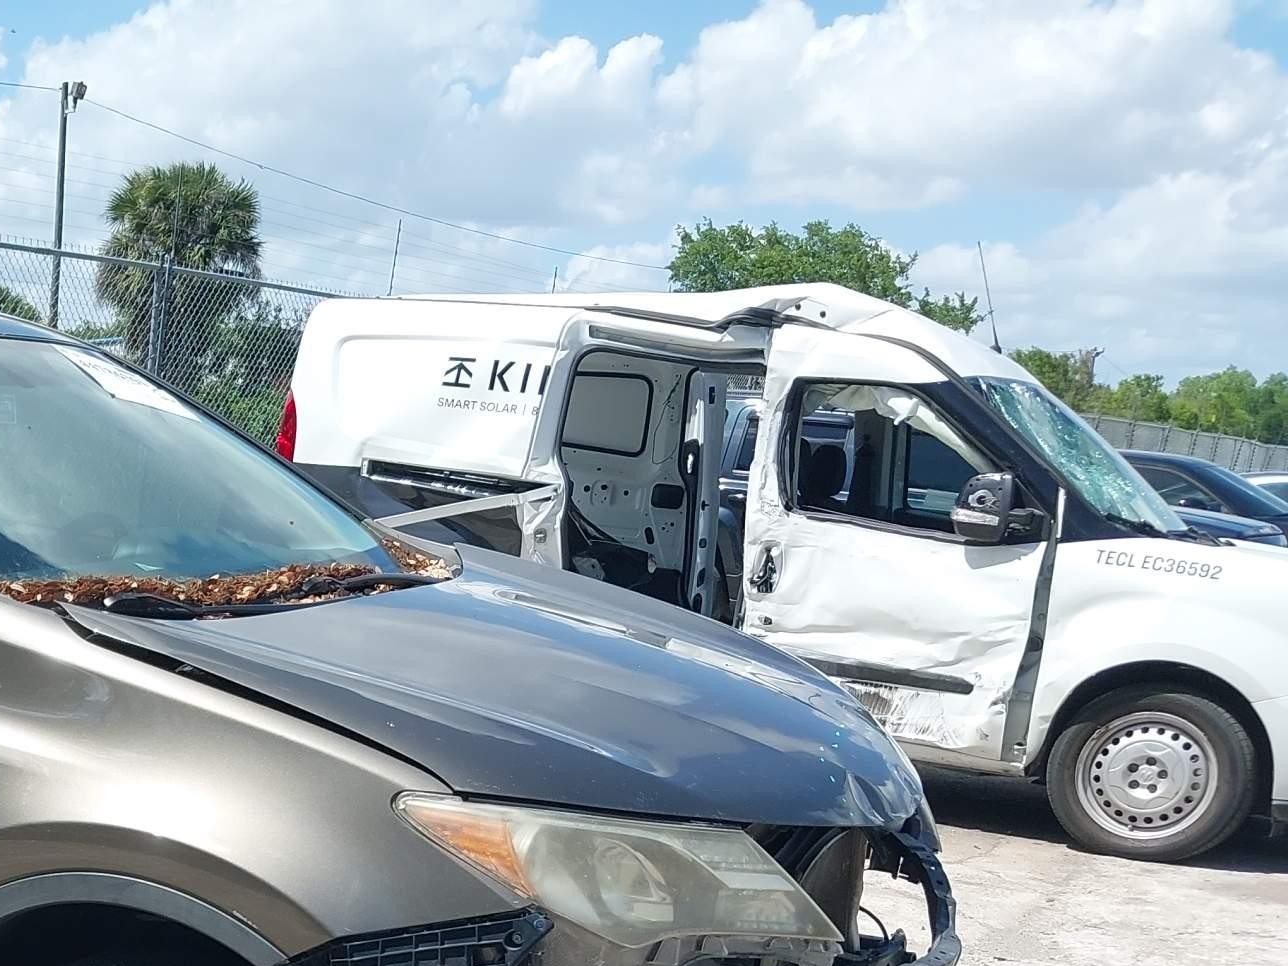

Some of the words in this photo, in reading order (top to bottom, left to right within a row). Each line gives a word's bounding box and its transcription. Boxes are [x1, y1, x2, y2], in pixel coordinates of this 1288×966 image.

[437, 397, 477, 411] SMART
[480, 401, 518, 415] SOLAR
[1096, 549, 1136, 569] TECL
[1141, 555, 1223, 579] EC36592
